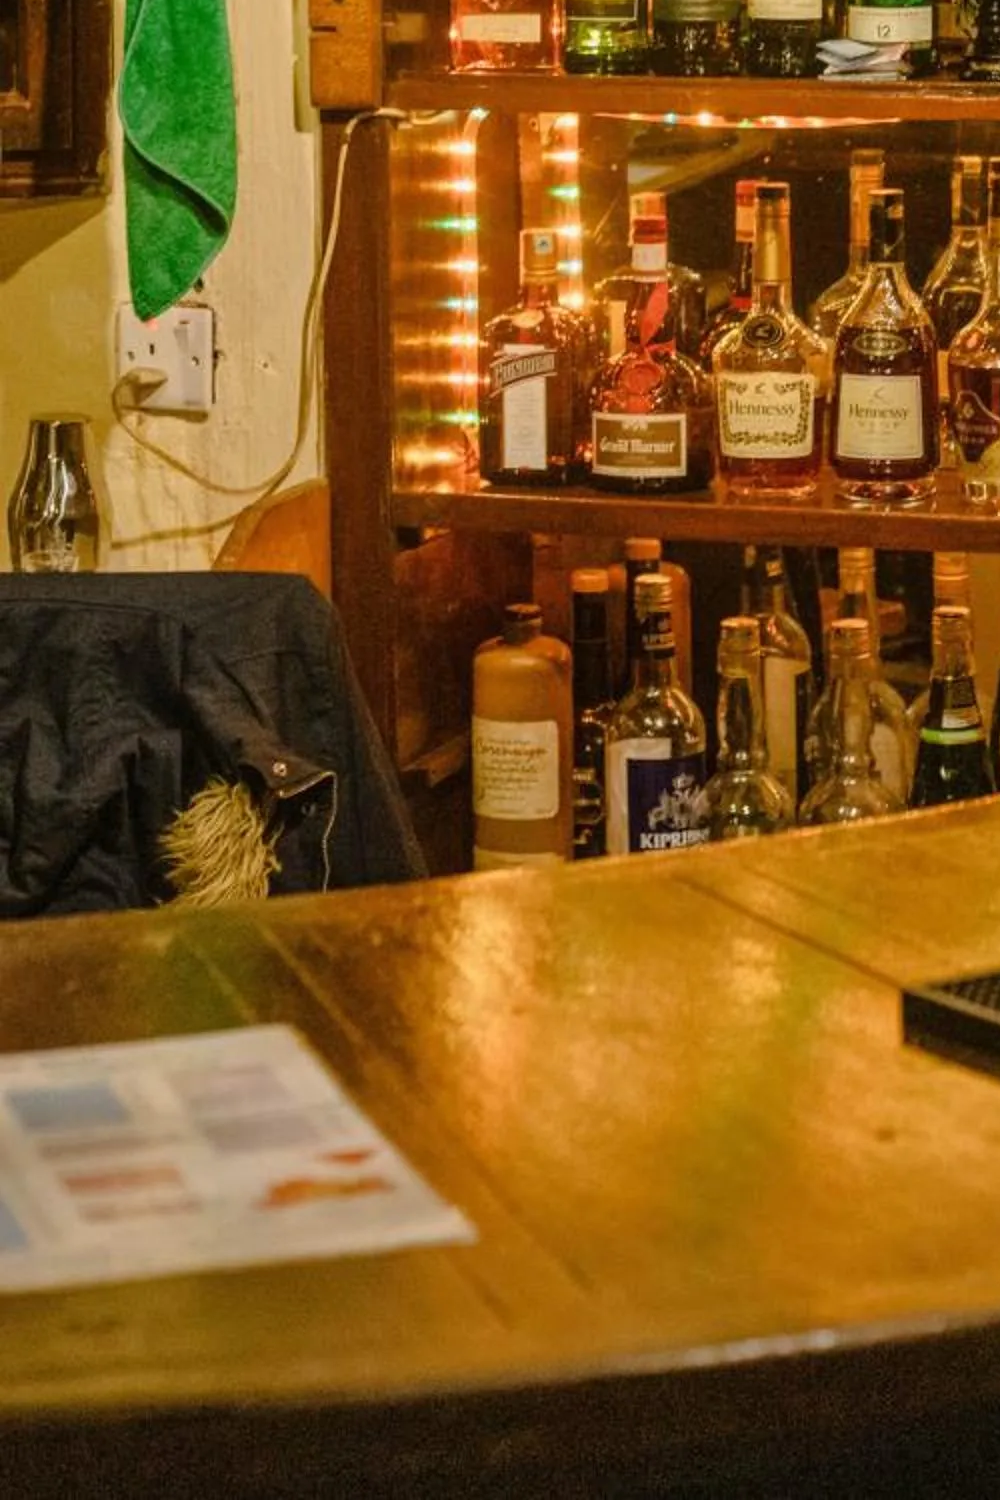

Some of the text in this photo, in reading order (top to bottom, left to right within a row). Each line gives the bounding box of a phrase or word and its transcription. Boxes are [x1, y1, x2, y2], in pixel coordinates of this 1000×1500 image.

[876, 24, 891, 38] 12
[729, 400, 797, 419] Hennessy
[849, 403, 911, 421] Hennessy
